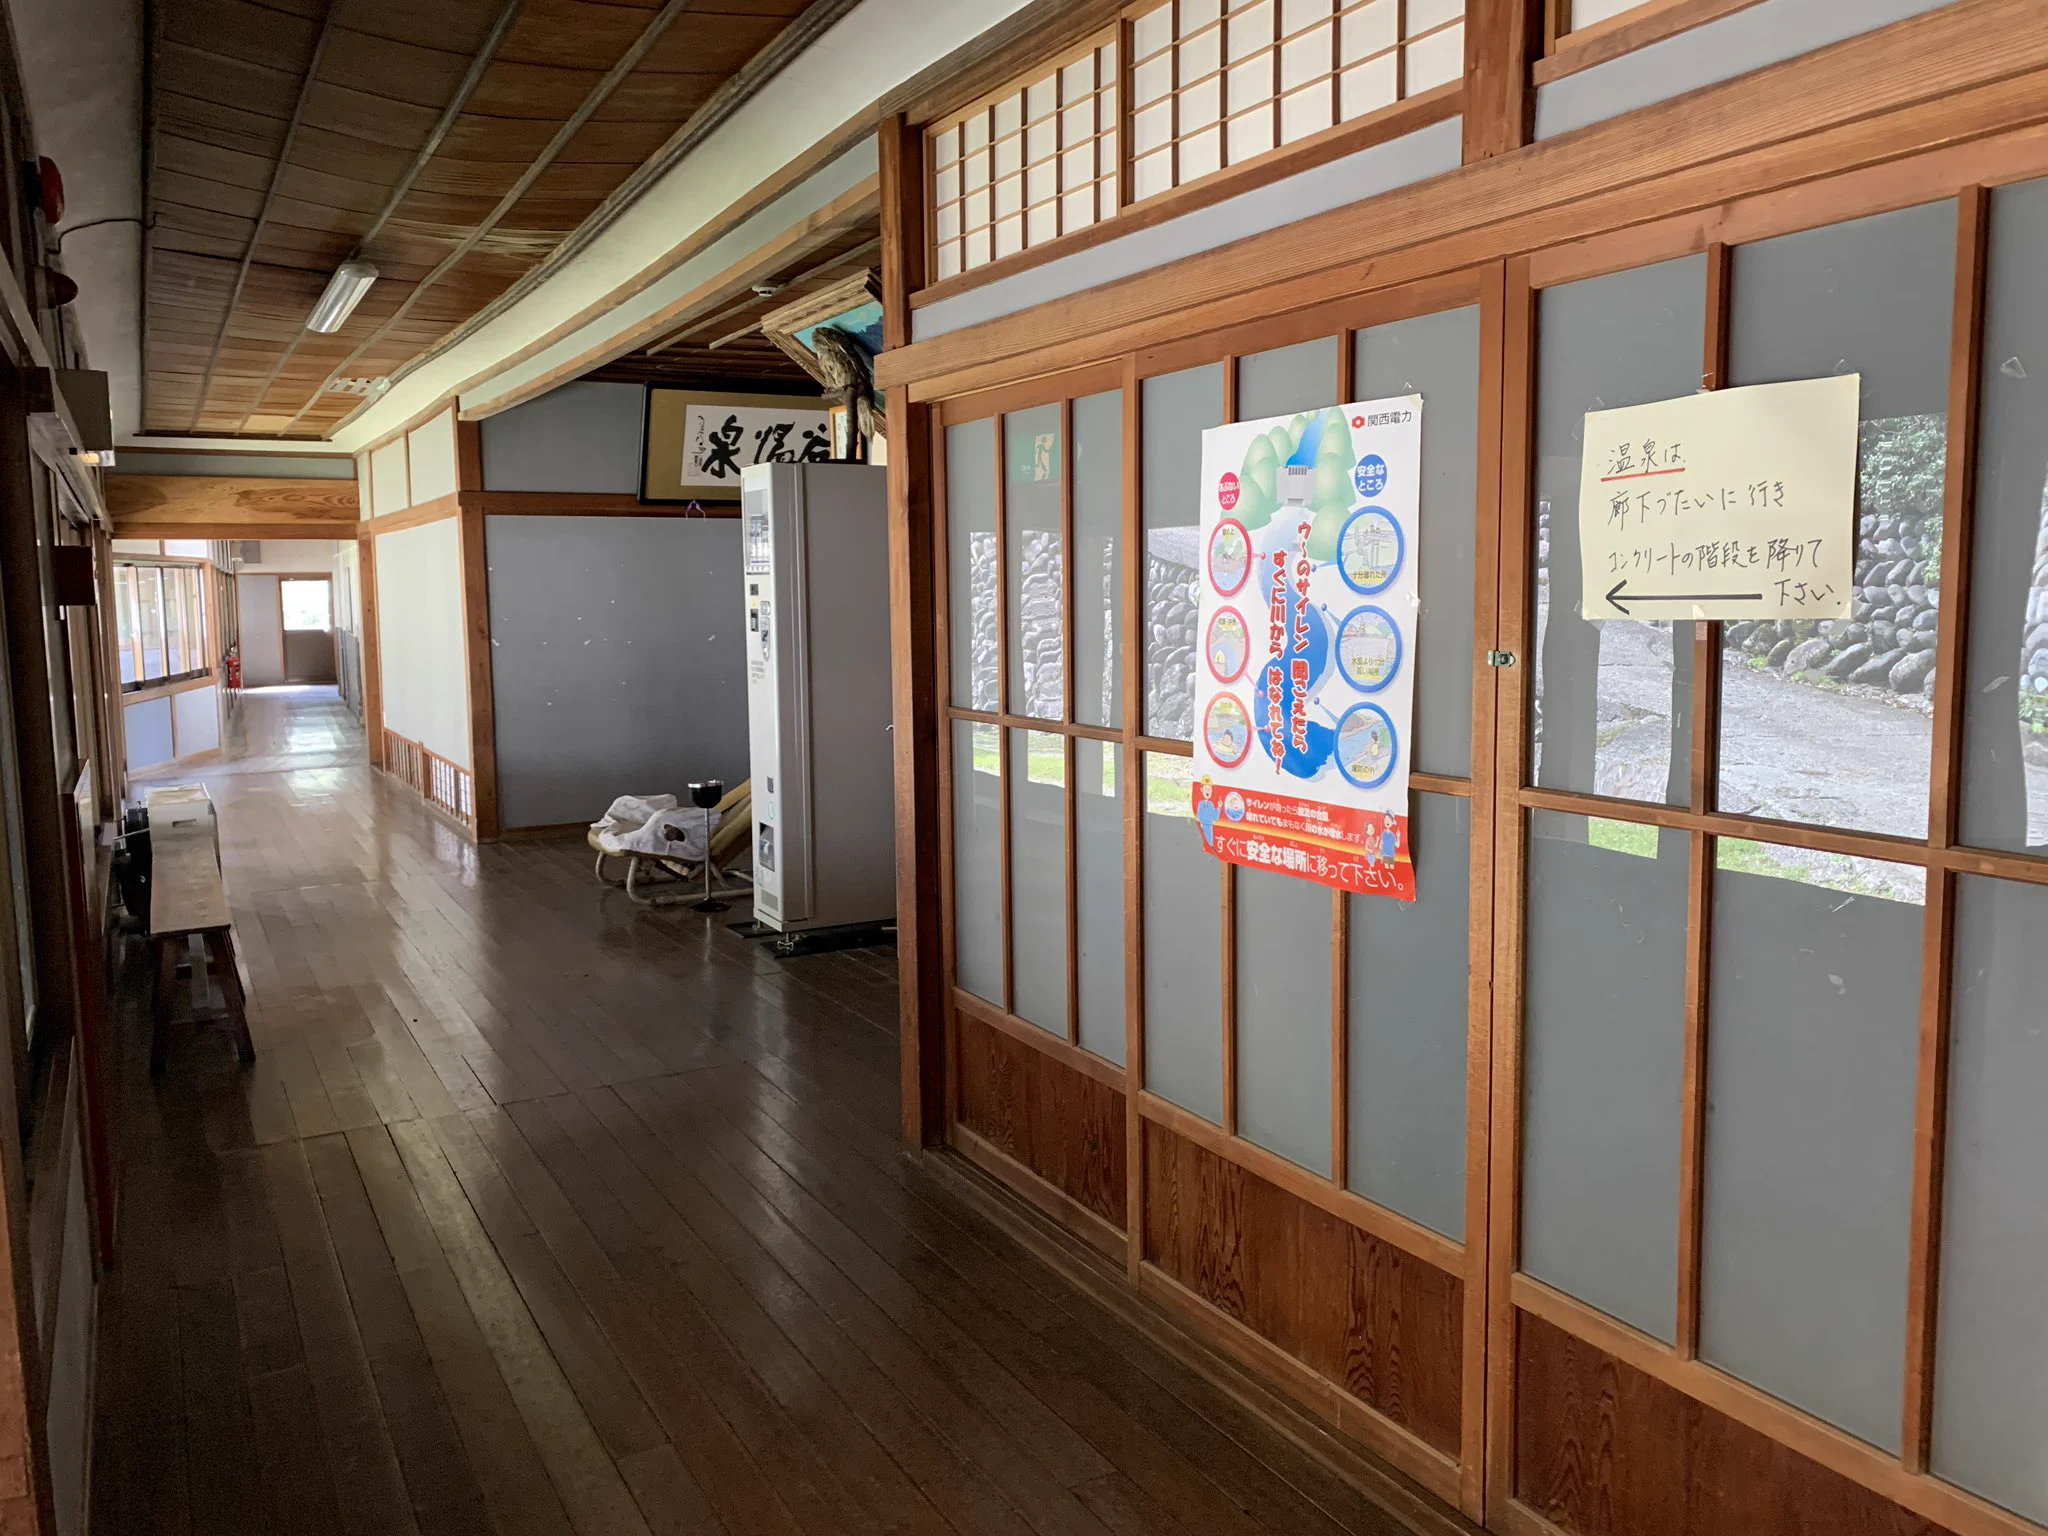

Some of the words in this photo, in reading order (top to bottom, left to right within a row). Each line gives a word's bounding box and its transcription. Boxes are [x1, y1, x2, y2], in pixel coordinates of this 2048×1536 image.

[1367, 411, 1412, 427] 関西電力
[1357, 464, 1385, 477] 安全な
[1358, 478, 1384, 492] ところ
[1609, 538, 1823, 576] コンクリートの階段を降りて
[1268, 550, 1288, 659] すぐに川から
[1290, 659, 1309, 753] 聞こえたら
[1215, 835, 1404, 891] すぐに安全な場所に移って下さい。
